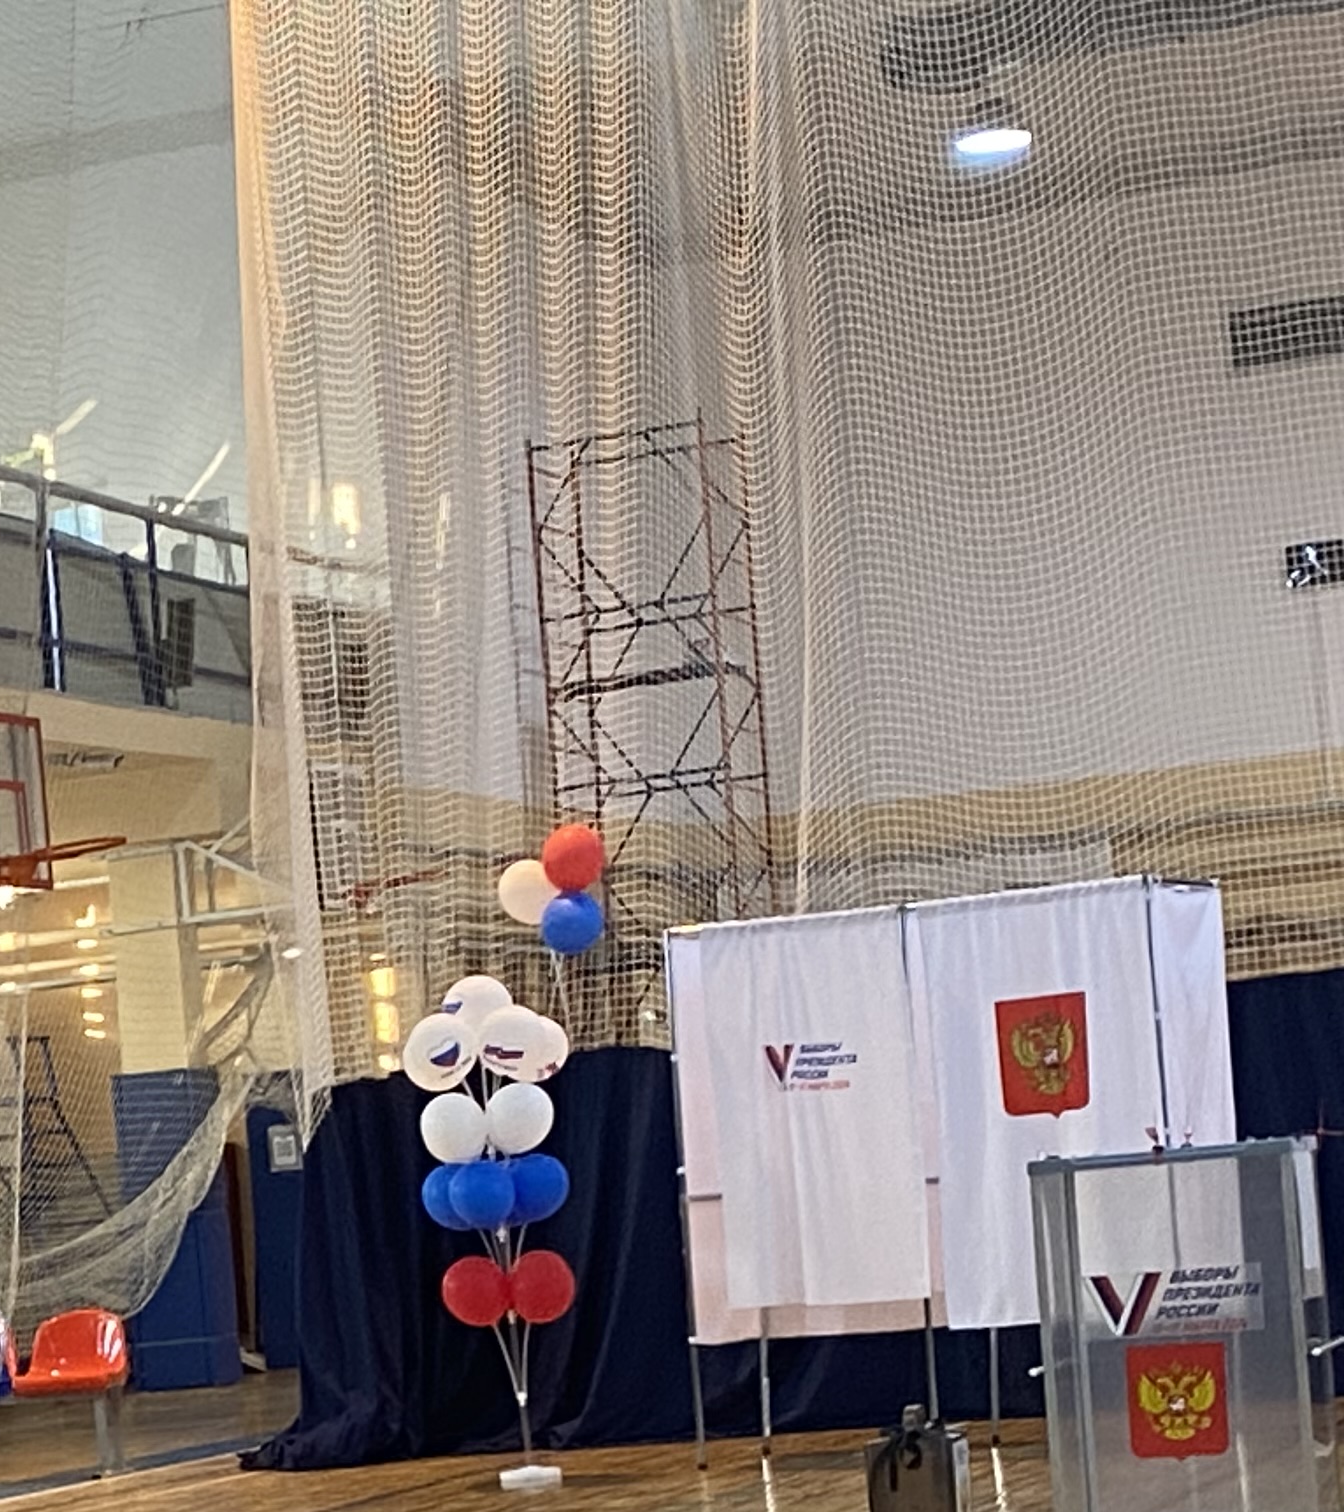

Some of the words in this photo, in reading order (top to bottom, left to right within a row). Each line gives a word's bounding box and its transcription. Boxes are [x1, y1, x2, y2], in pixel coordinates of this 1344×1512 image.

[1169, 1266, 1240, 1284] ВЫБОРЫ
[1162, 1282, 1261, 1301] ПРЕЗИДЕНТА
[1155, 1303, 1220, 1320] РОССИИ
